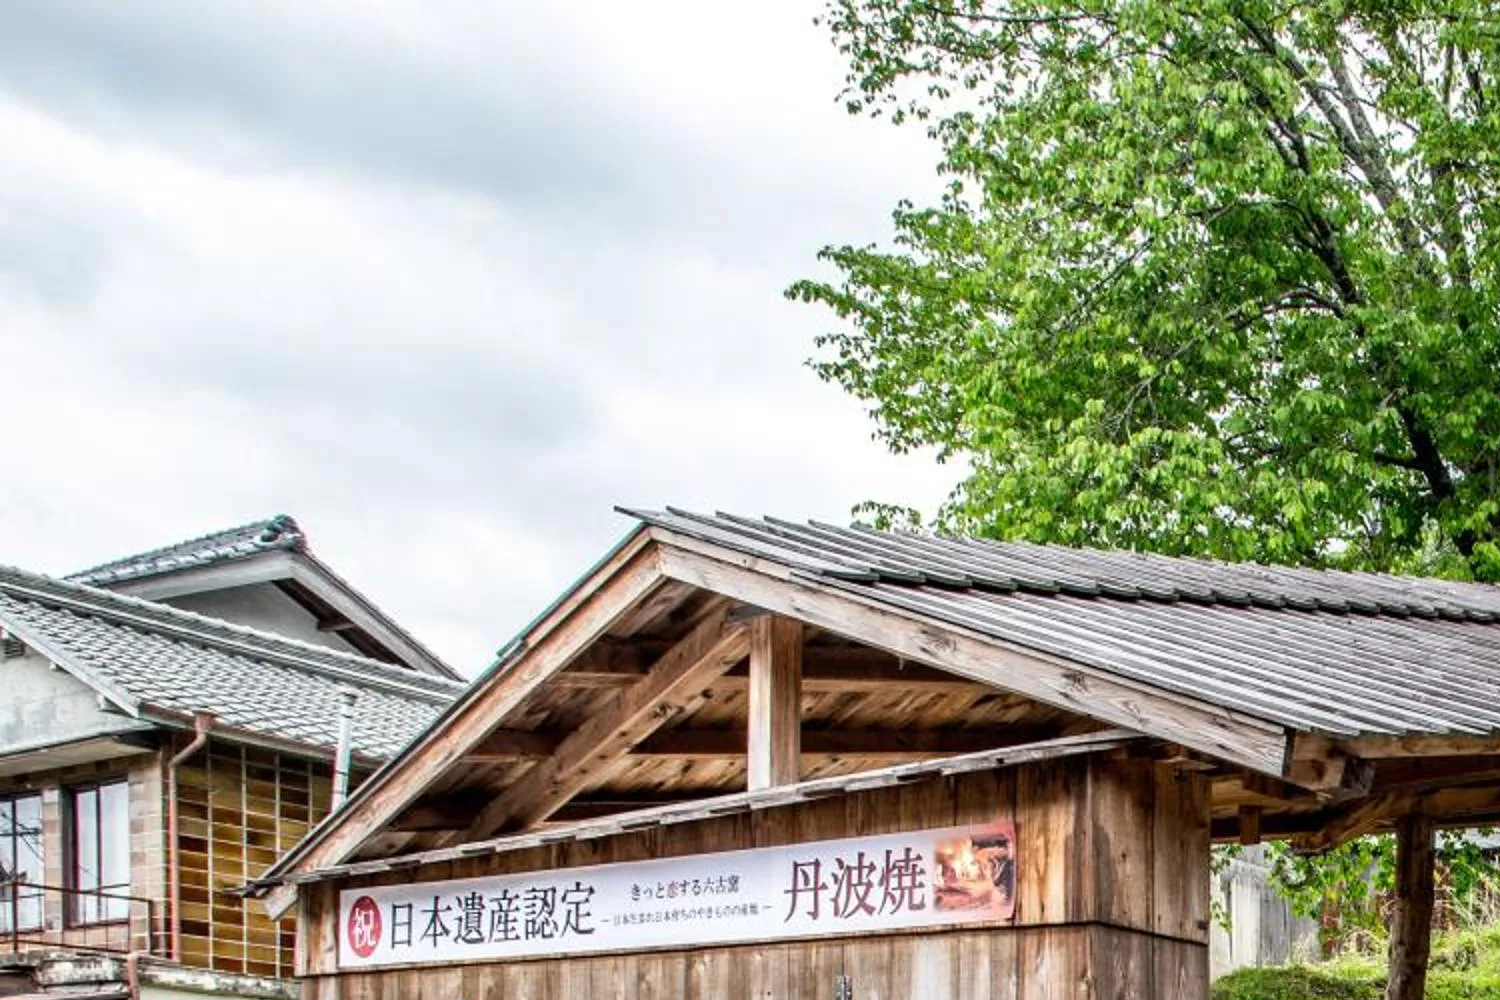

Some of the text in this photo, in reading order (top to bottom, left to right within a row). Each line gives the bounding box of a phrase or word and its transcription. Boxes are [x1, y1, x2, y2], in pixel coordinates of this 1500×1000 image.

[353, 847, 926, 949] 祝 日本遺産認定 丹波焼
